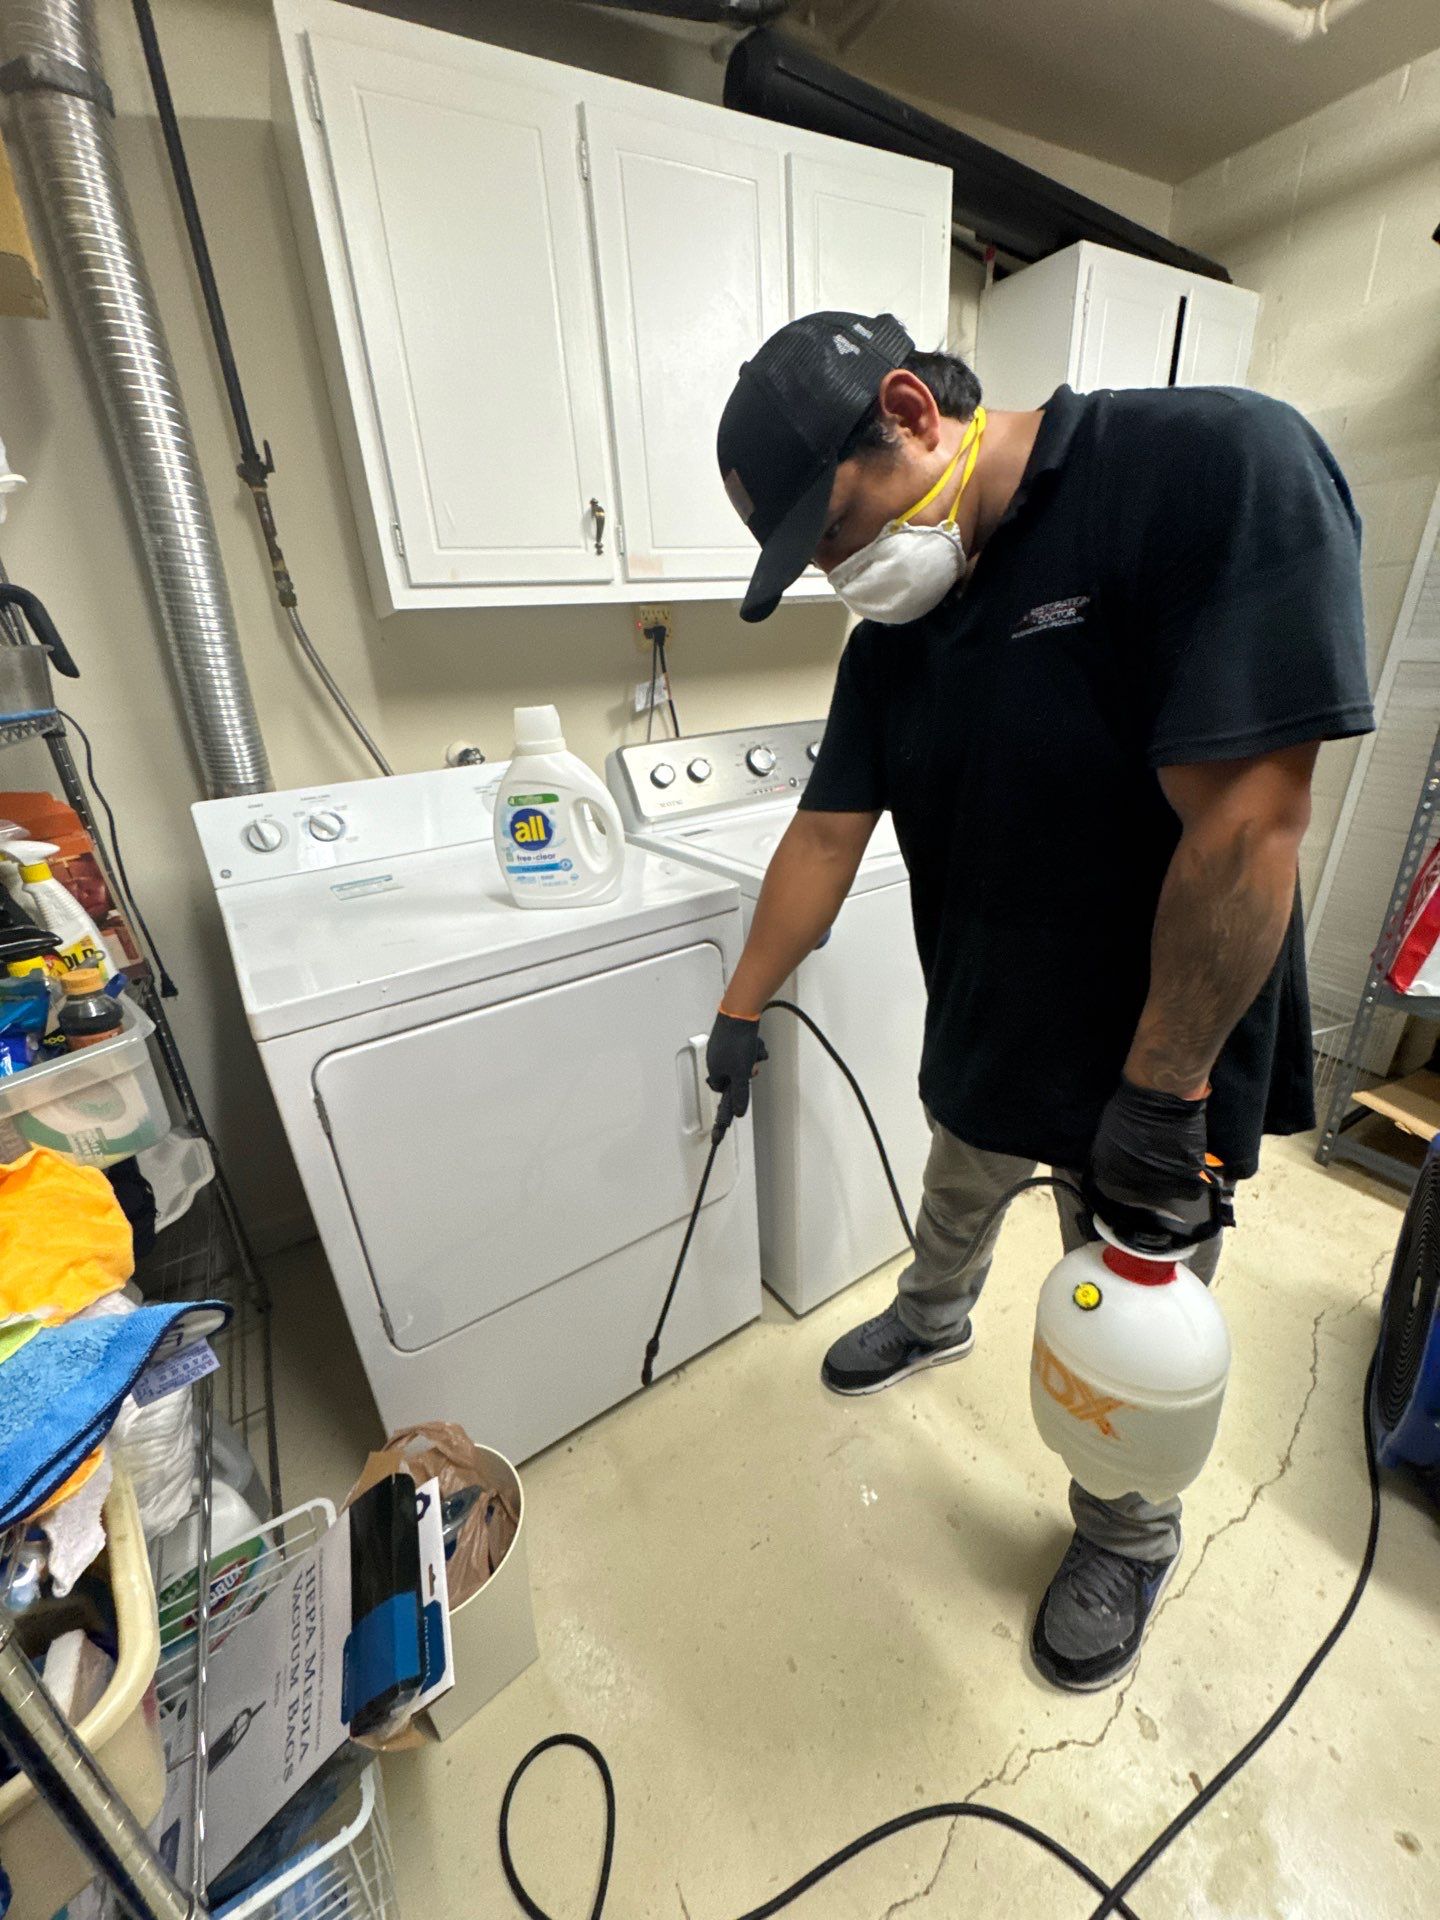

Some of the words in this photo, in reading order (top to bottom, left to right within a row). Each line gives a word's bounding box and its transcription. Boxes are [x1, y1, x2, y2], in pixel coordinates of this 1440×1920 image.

[1038, 608, 1077, 625] DOCTOR
[514, 815, 545, 843] all
[516, 854, 532, 862] free
[288, 1573, 303, 1689] VACUUM
[305, 1563, 317, 1648] HEPA
[283, 1698, 300, 1783] BAGS
[299, 1653, 316, 1764] MEDIA
